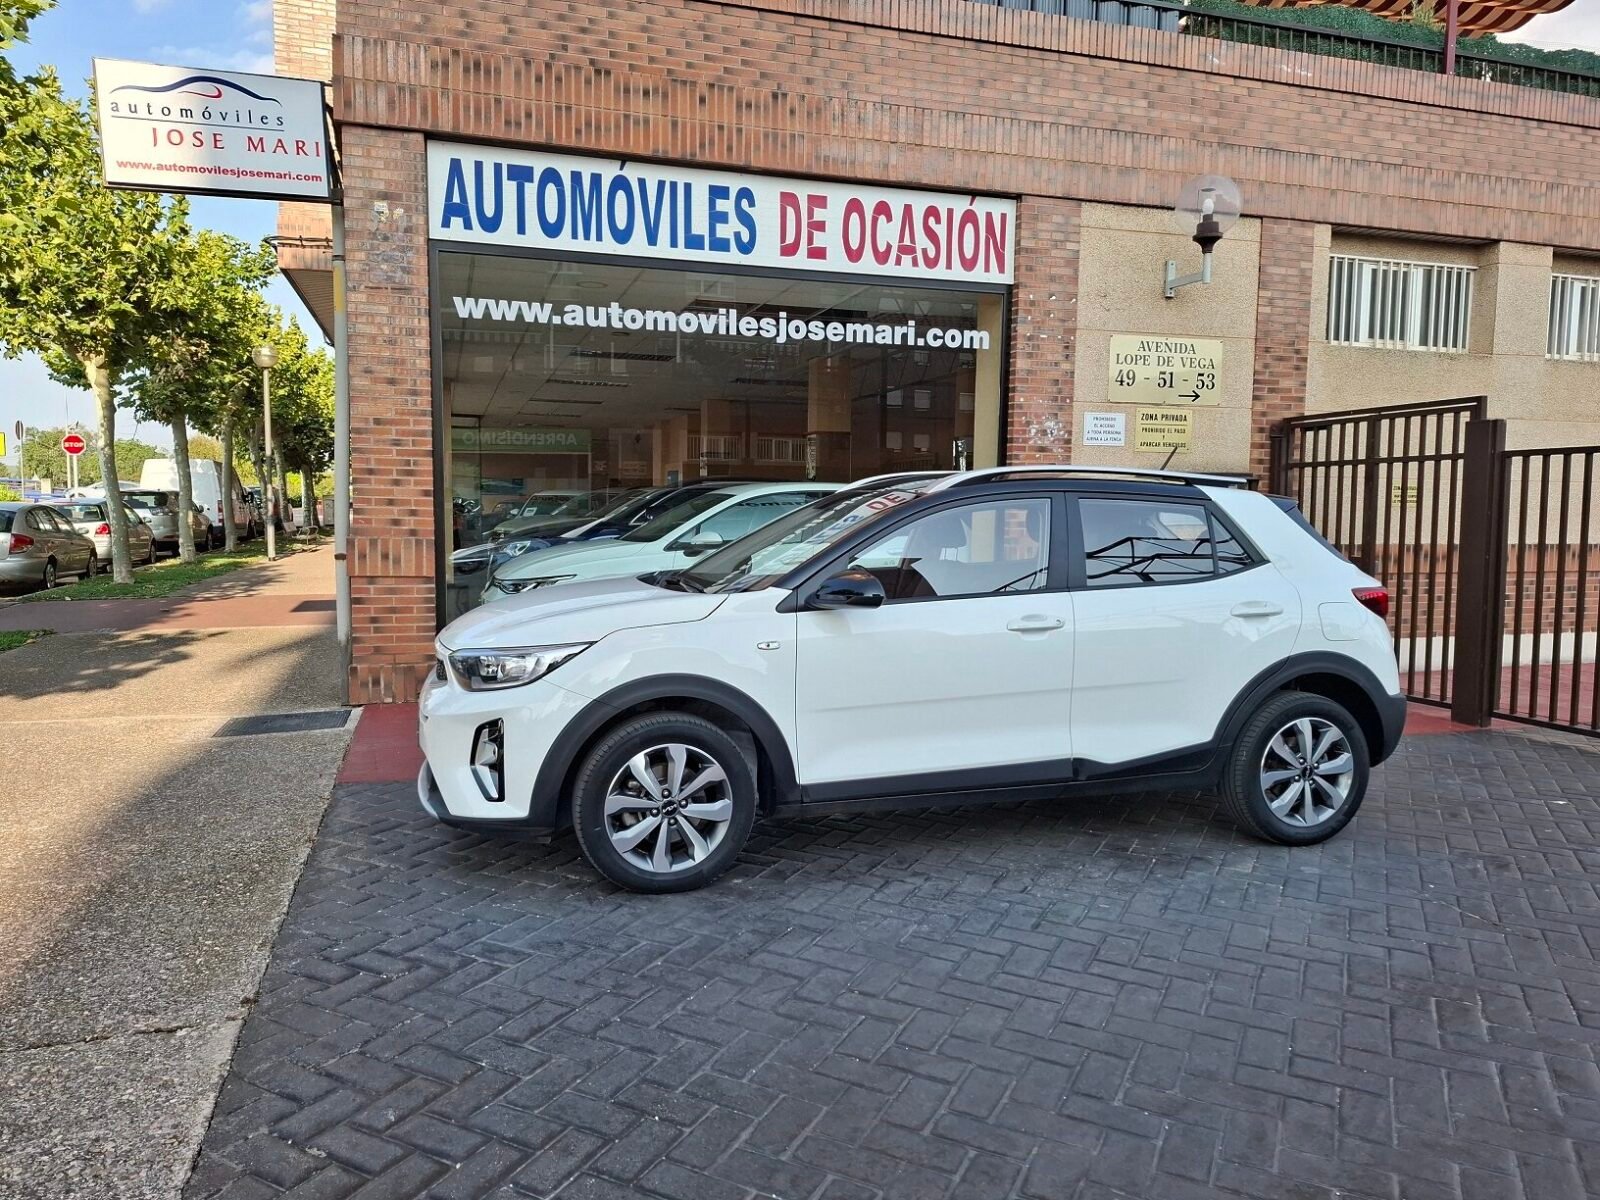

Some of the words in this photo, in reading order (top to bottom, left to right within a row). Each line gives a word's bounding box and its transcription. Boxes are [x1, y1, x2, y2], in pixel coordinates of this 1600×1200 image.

[110, 100, 284, 127] automóviles
[152, 127, 225, 149] JOSE
[247, 135, 321, 157] MARI
[116, 159, 322, 182] www.automovilesjosemari.com
[441, 157, 757, 256] AUTOMÓVILES
[779, 191, 828, 260] DE
[842, 195, 1007, 275] OCASIÓN
[453, 296, 990, 349] www.automovilesjosemari.com
[1137, 340, 1196, 355] AVENIDA
[1116, 353, 1151, 366] LOPE
[1157, 355, 1174, 367] DE
[1180, 356, 1215, 370] VEGA
[1115, 369, 1136, 387] 49
[1157, 371, 1175, 388] 51
[1195, 373, 1215, 390] 53
[1140, 413, 1158, 421] ZONA
[1161, 414, 1187, 422] PRIVADA
